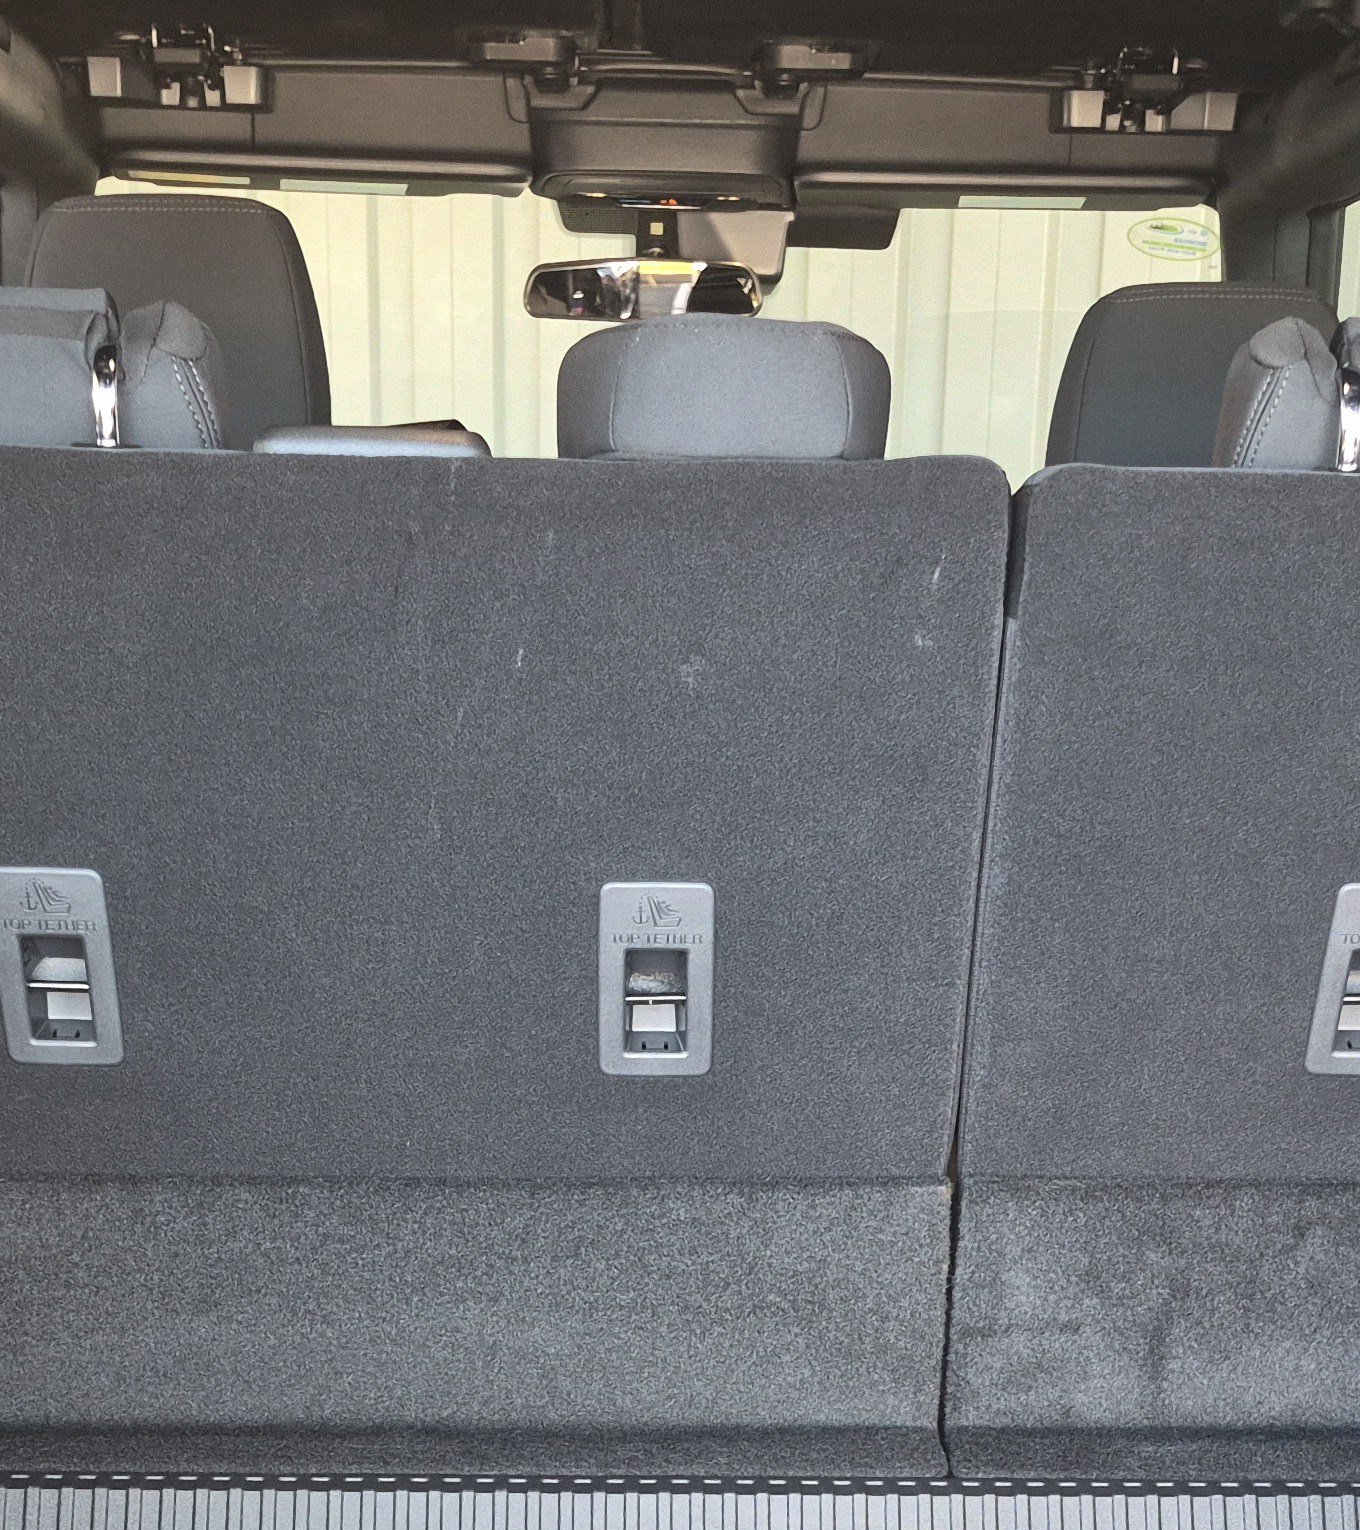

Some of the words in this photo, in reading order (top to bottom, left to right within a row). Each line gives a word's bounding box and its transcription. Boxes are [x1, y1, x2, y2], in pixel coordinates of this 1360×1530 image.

[3, 919, 31, 931] TOP
[35, 919, 97, 933] TETHER
[611, 933, 641, 945] TOP
[645, 933, 704, 945] TETHER
